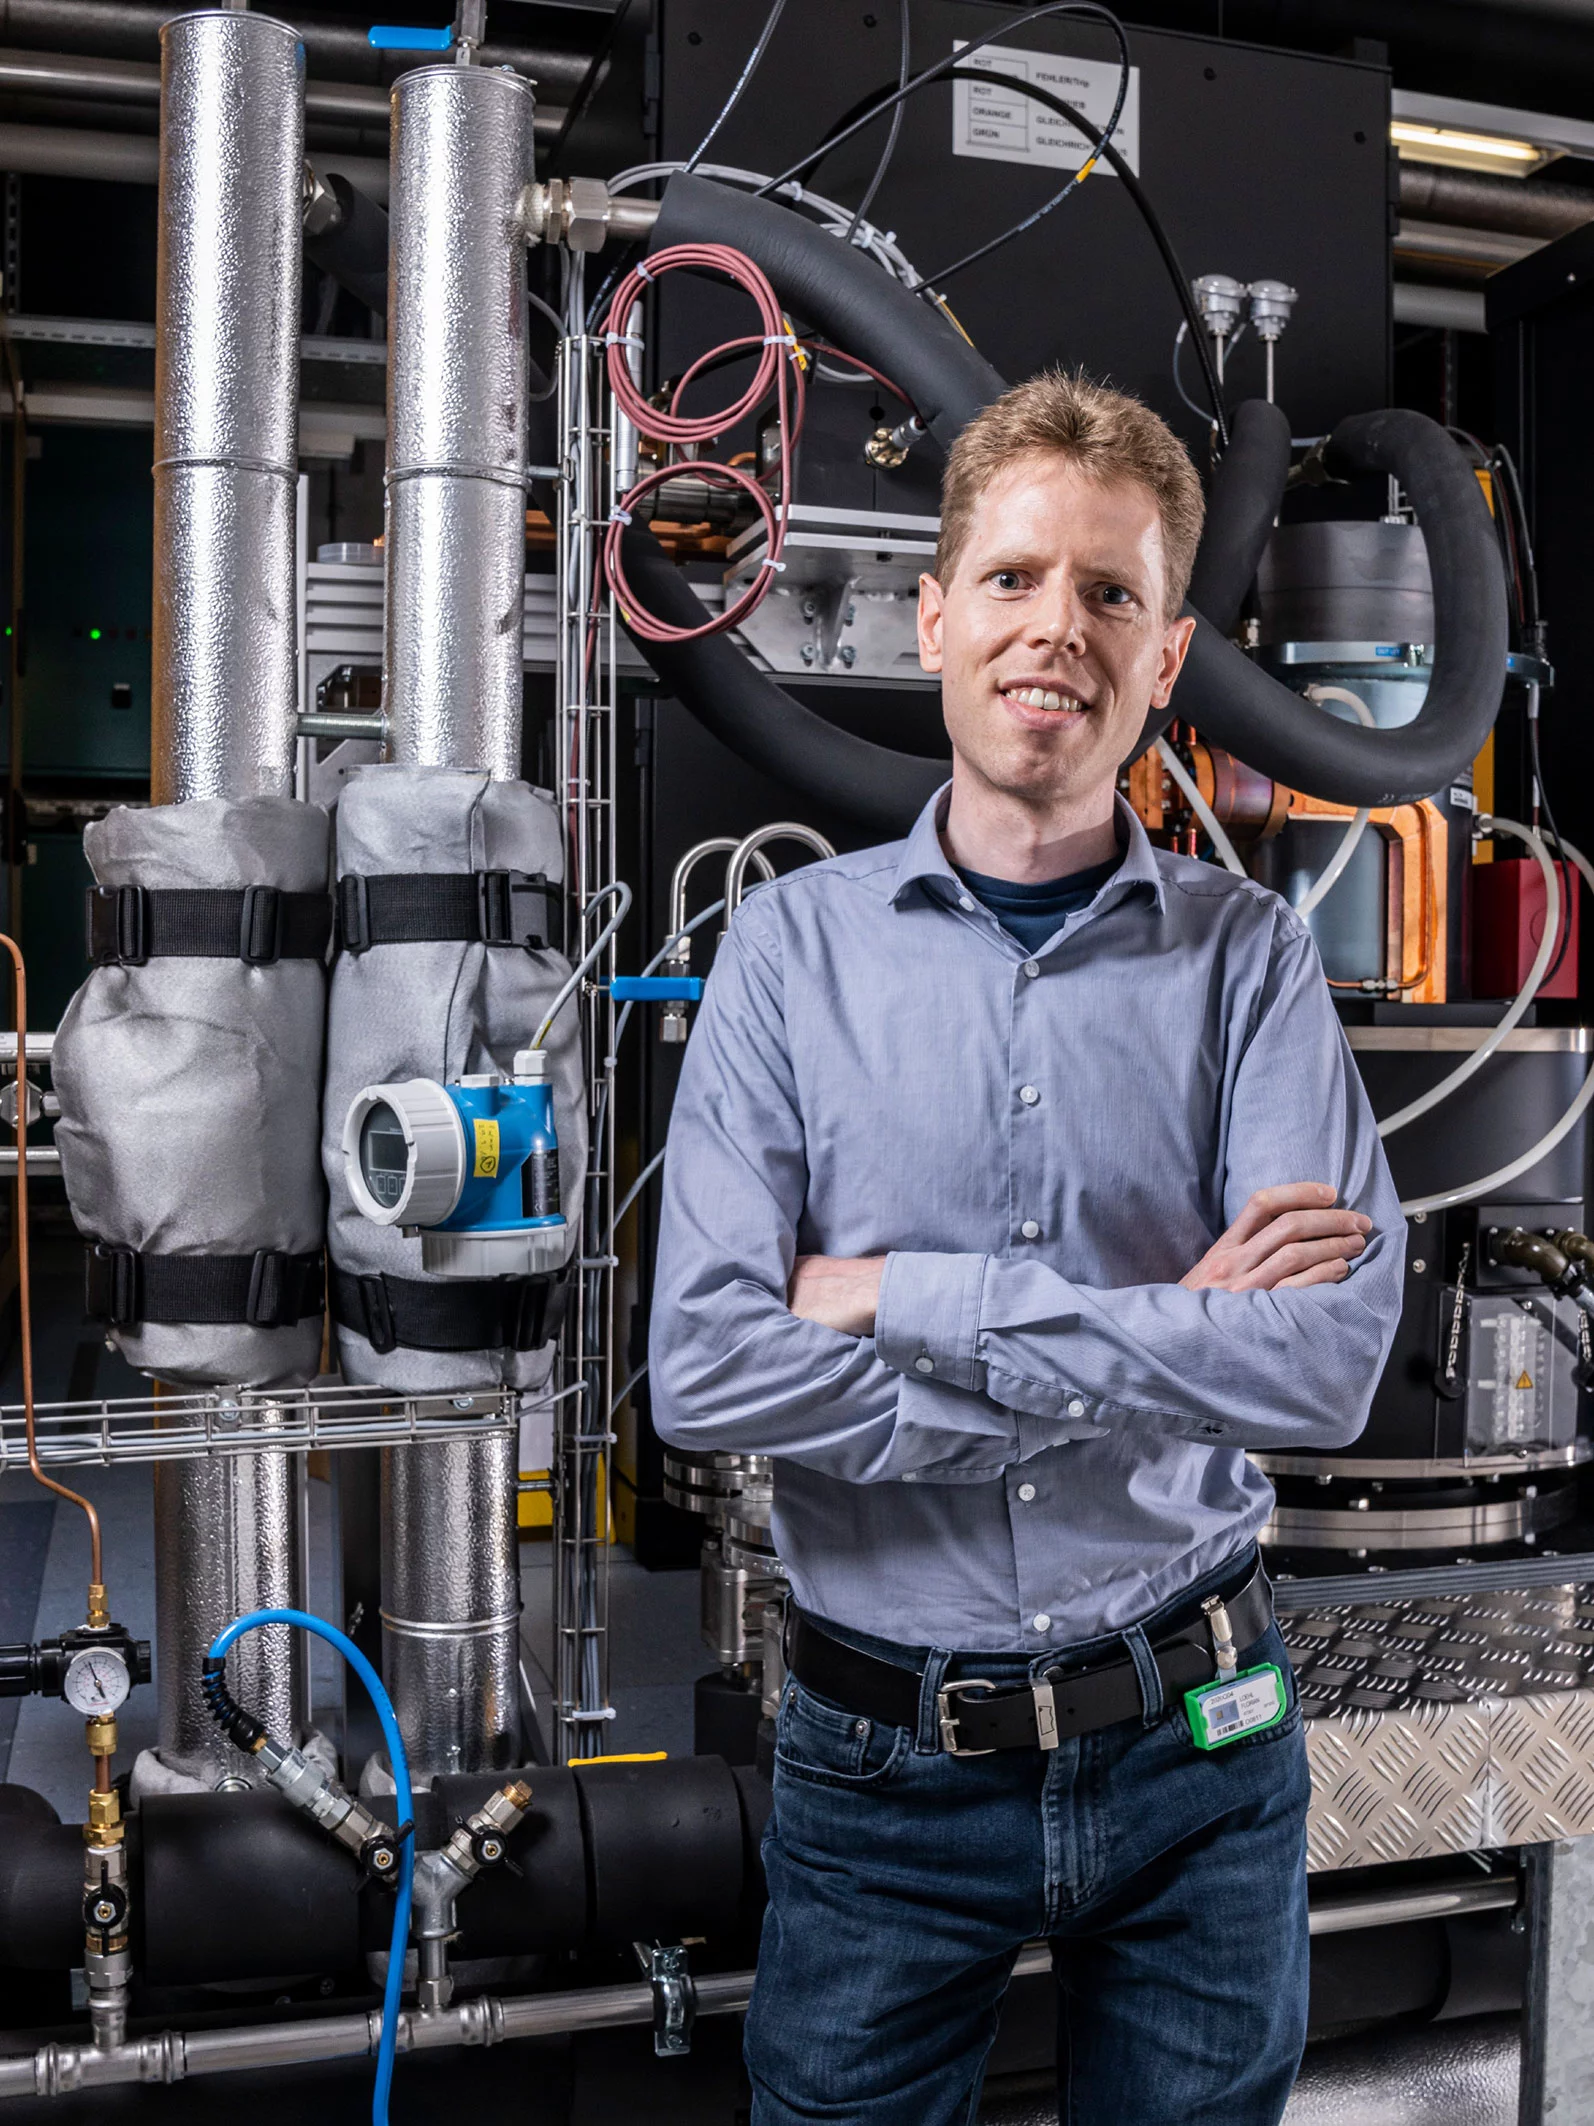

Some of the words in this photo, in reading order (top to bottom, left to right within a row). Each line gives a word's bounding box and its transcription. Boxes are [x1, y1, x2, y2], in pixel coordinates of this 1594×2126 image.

[974, 87, 991, 96] ROT
[973, 108, 1011, 119] ORANGE
[973, 128, 1000, 138] GRÜN
